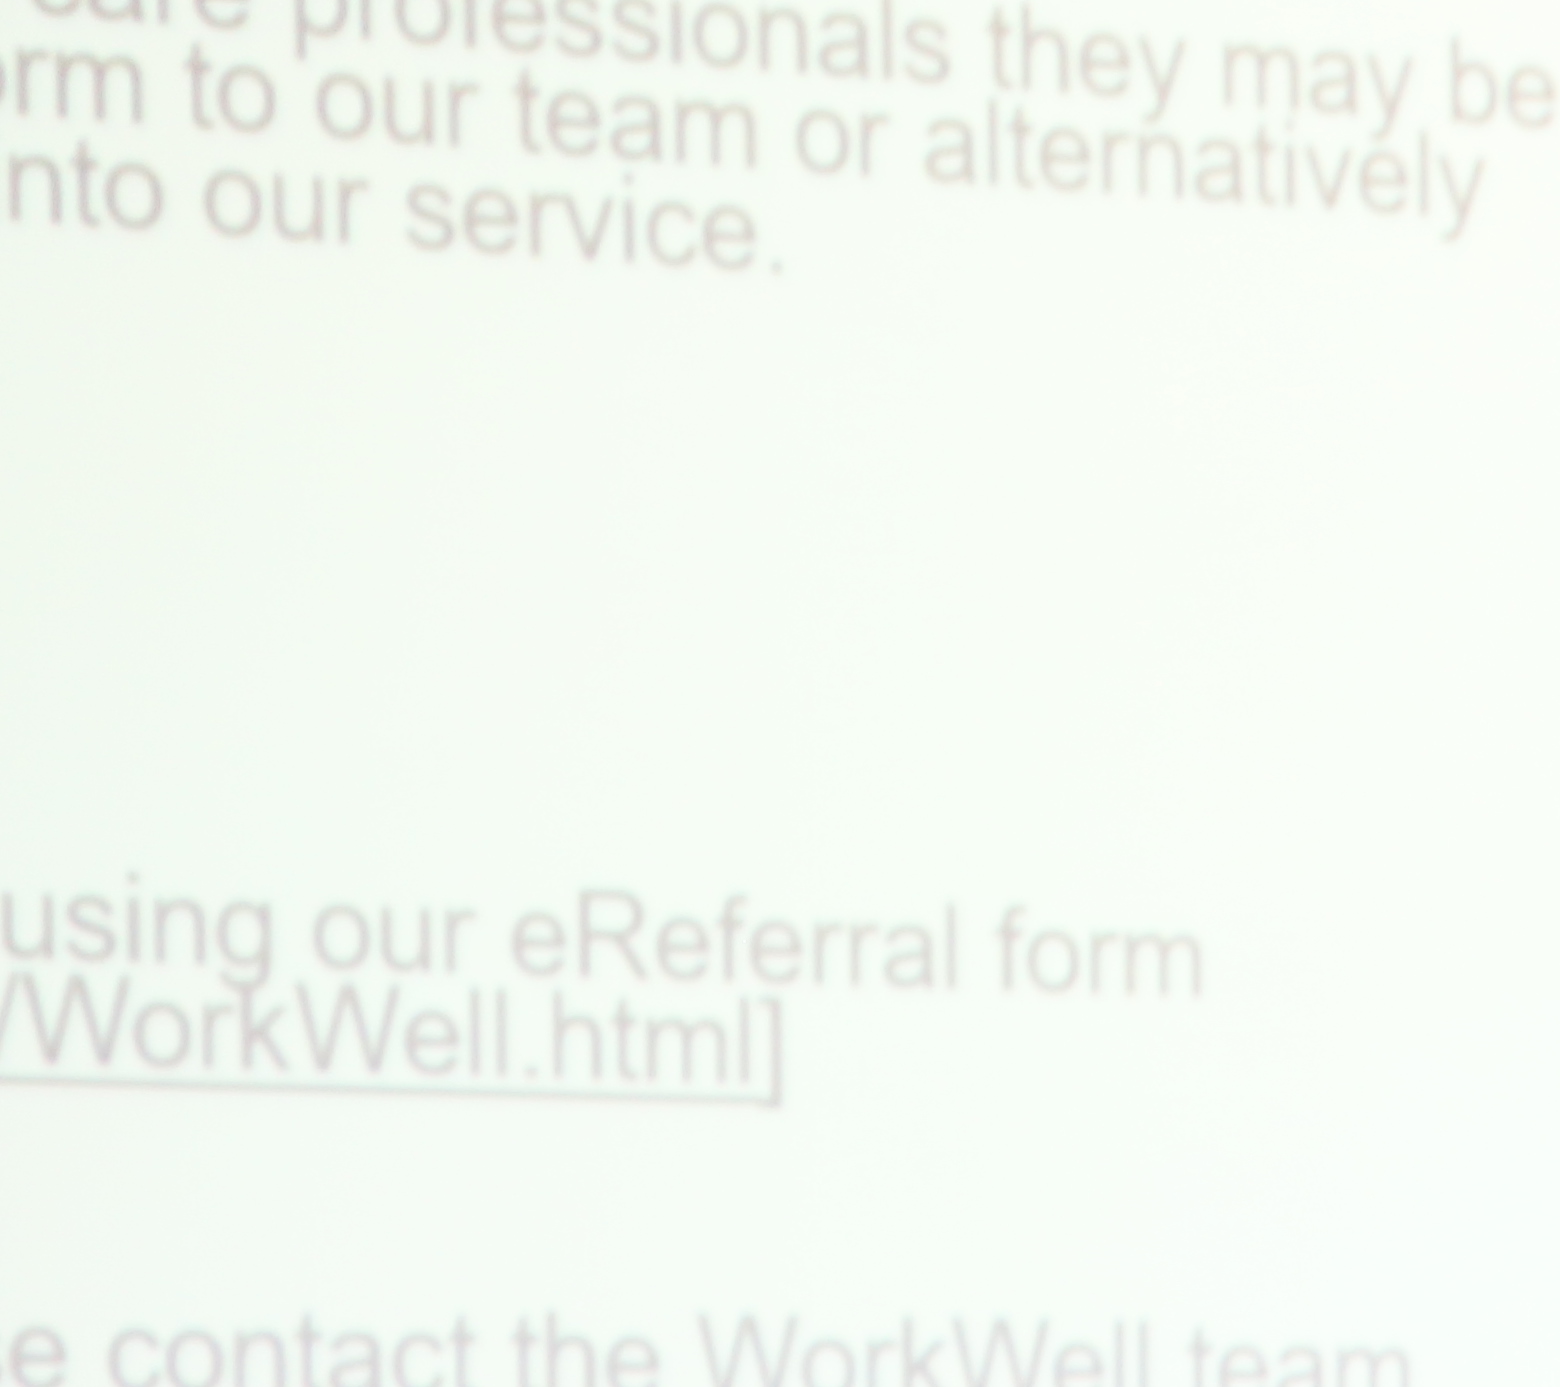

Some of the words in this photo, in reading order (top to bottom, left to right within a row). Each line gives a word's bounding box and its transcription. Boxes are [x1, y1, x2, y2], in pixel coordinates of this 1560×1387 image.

[988, 0, 1186, 122] they
[1221, 41, 1413, 139] may
[1449, 36, 1558, 129] be
[0, 47, 144, 124] rm
[184, 44, 278, 134] to
[314, 72, 480, 148] our
[515, 66, 756, 169] team
[795, 108, 887, 178] or
[923, 99, 1484, 242] alternatively
[202, 168, 368, 244] our
[405, 170, 783, 275] service.
[0, 872, 274, 990] using
[311, 902, 475, 973] our
[510, 886, 960, 990] eReferral
[995, 903, 1204, 996] form
